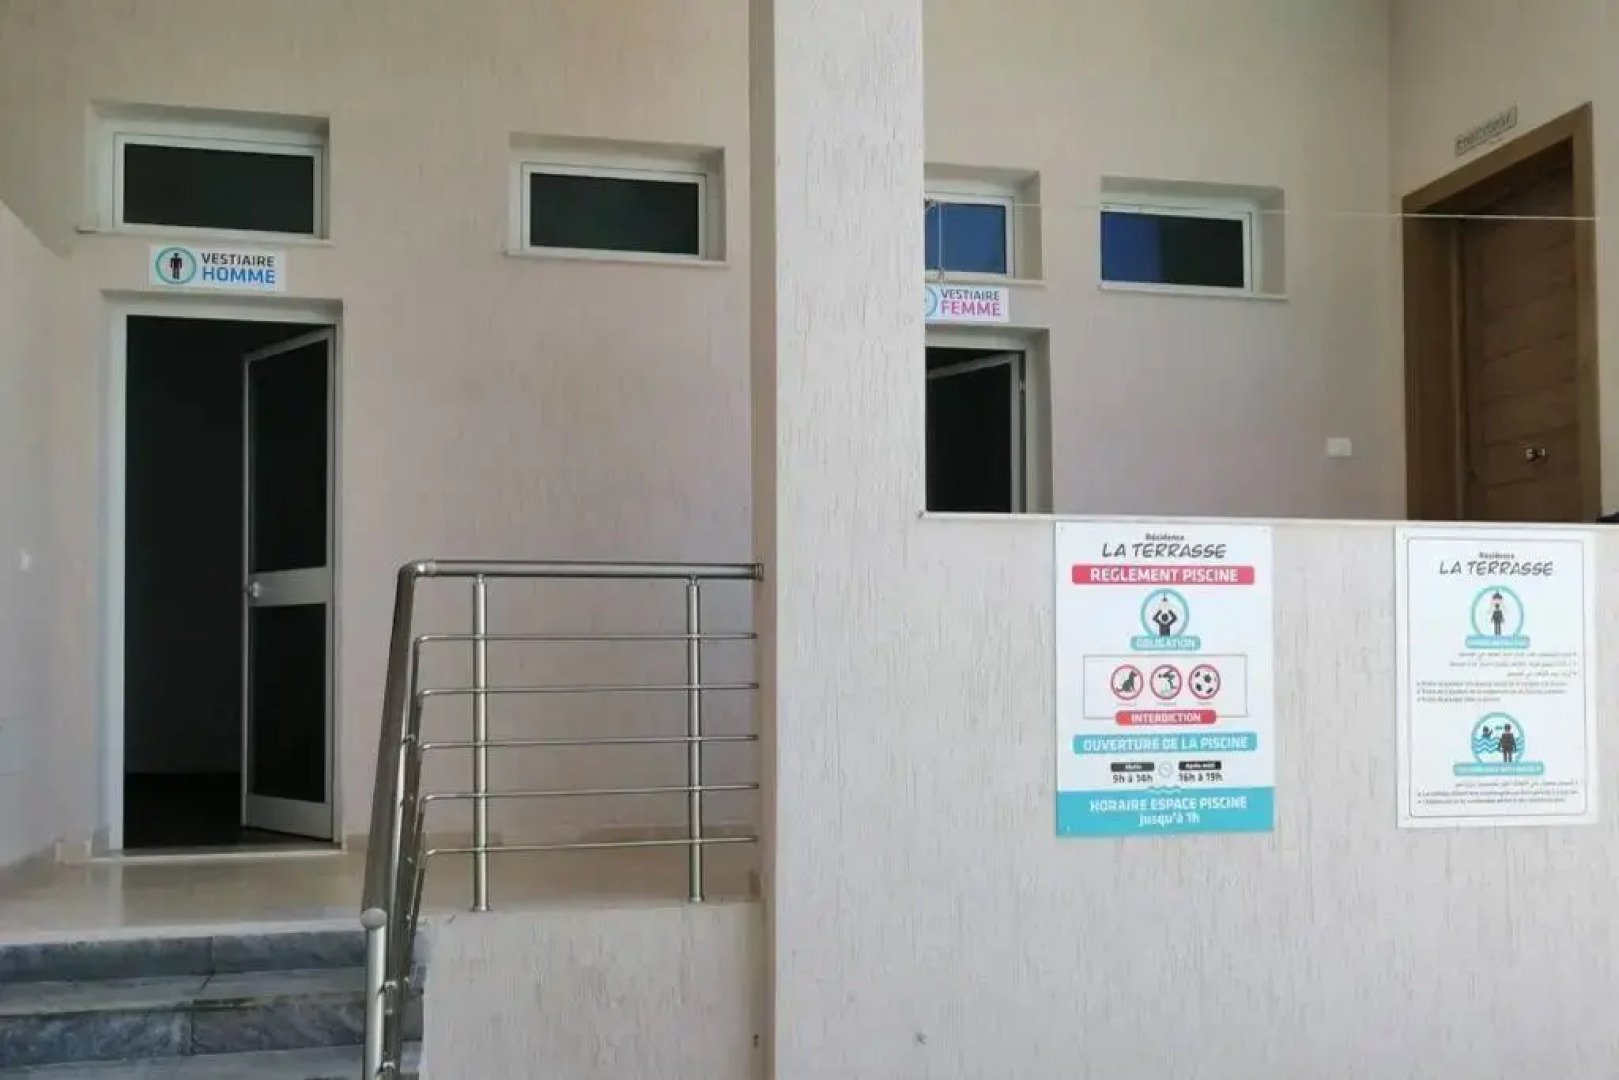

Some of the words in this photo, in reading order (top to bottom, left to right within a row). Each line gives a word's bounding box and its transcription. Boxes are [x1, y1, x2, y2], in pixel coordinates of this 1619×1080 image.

[201, 252, 276, 267] VESTIAIRE
[202, 266, 276, 284] HOMME
[941, 287, 999, 301] VESTIAIRE
[941, 301, 1001, 317] FEMME
[1101, 543, 1127, 557] LA
[1131, 543, 1227, 559] TERRASSE
[1090, 568, 1179, 583] REGLEMENT
[1182, 568, 1239, 583] PISCINE
[1439, 561, 1463, 575] LA
[1466, 561, 1554, 576] TERRASSE
[1131, 712, 1201, 723] INTERDICTION
[1083, 738, 1159, 750] OUVERTURE
[1164, 738, 1179, 749] DE
[1181, 737, 1198, 749] LA
[1201, 736, 1249, 749] PISCINE
[1112, 774, 1126, 783] 9h
[1136, 773, 1154, 783] 14h
[1178, 772, 1196, 782] 16h
[1090, 799, 1148, 811] HORAIRE
[1151, 798, 1198, 810] ESPACE
[1200, 797, 1247, 809] PISCINE
